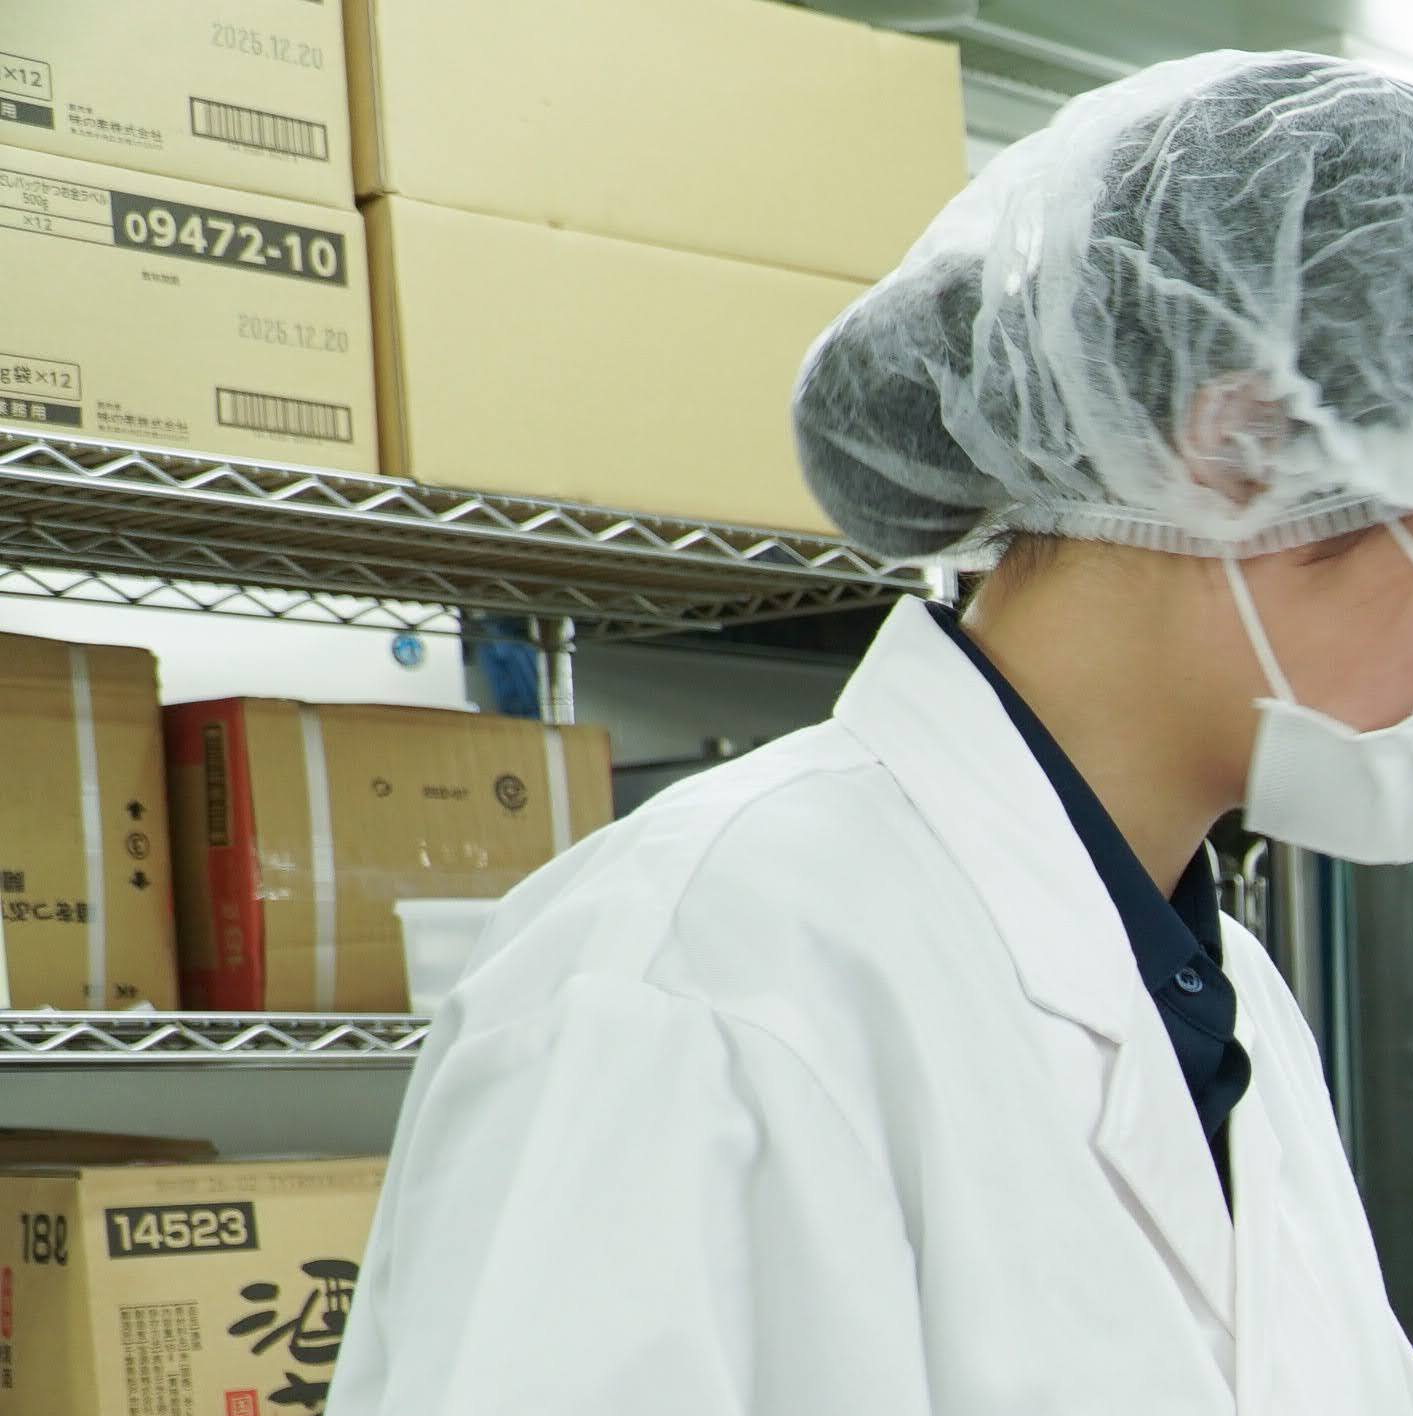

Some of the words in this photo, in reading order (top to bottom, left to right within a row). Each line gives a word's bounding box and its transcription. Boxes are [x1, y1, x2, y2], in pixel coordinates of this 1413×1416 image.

[211, 23, 324, 70] 2025.12.20
[125, 208, 337, 277] 09472-10
[112, 1208, 248, 1251] 14523
